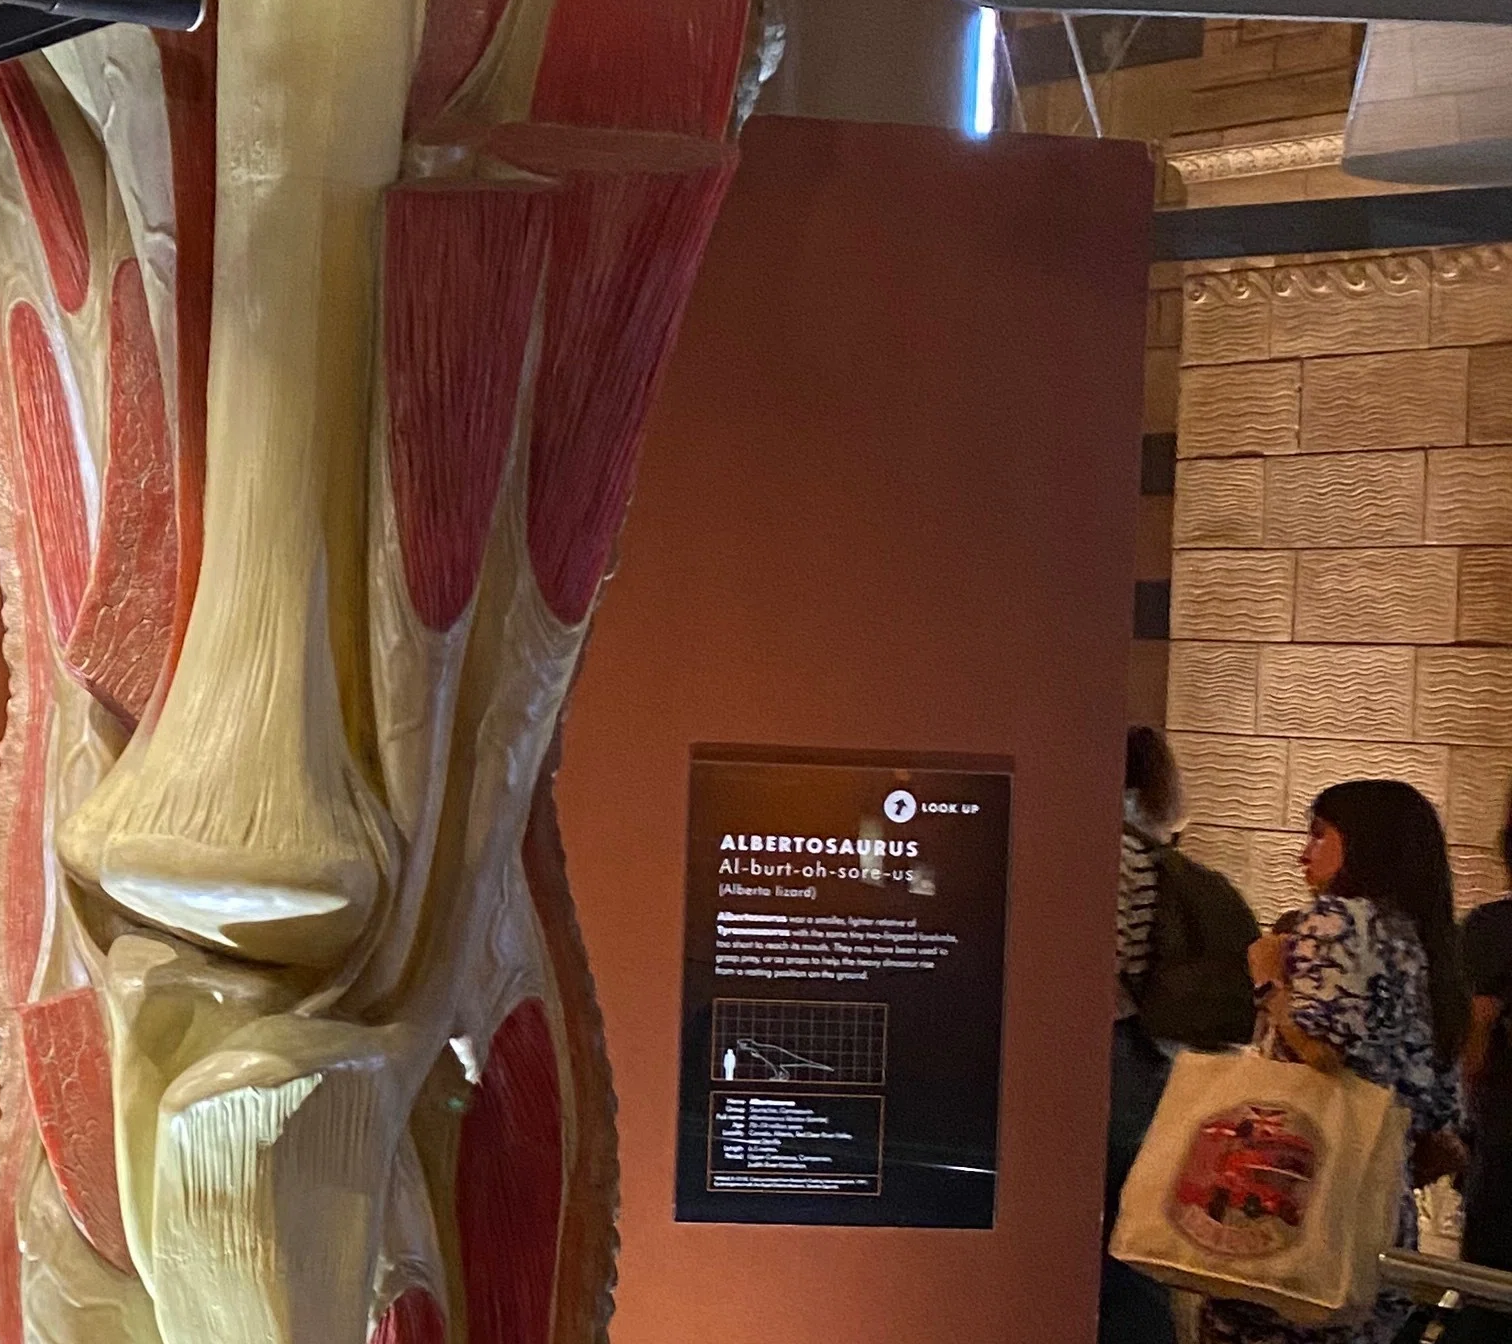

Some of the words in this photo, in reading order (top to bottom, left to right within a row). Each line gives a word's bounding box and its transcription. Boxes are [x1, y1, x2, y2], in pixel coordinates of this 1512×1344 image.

[921, 802, 959, 814] LOOK
[961, 803, 980, 814] UP
[720, 834, 918, 858] ALBERTOSAURUS
[718, 857, 914, 881] Al-burt-oh-sore-us
